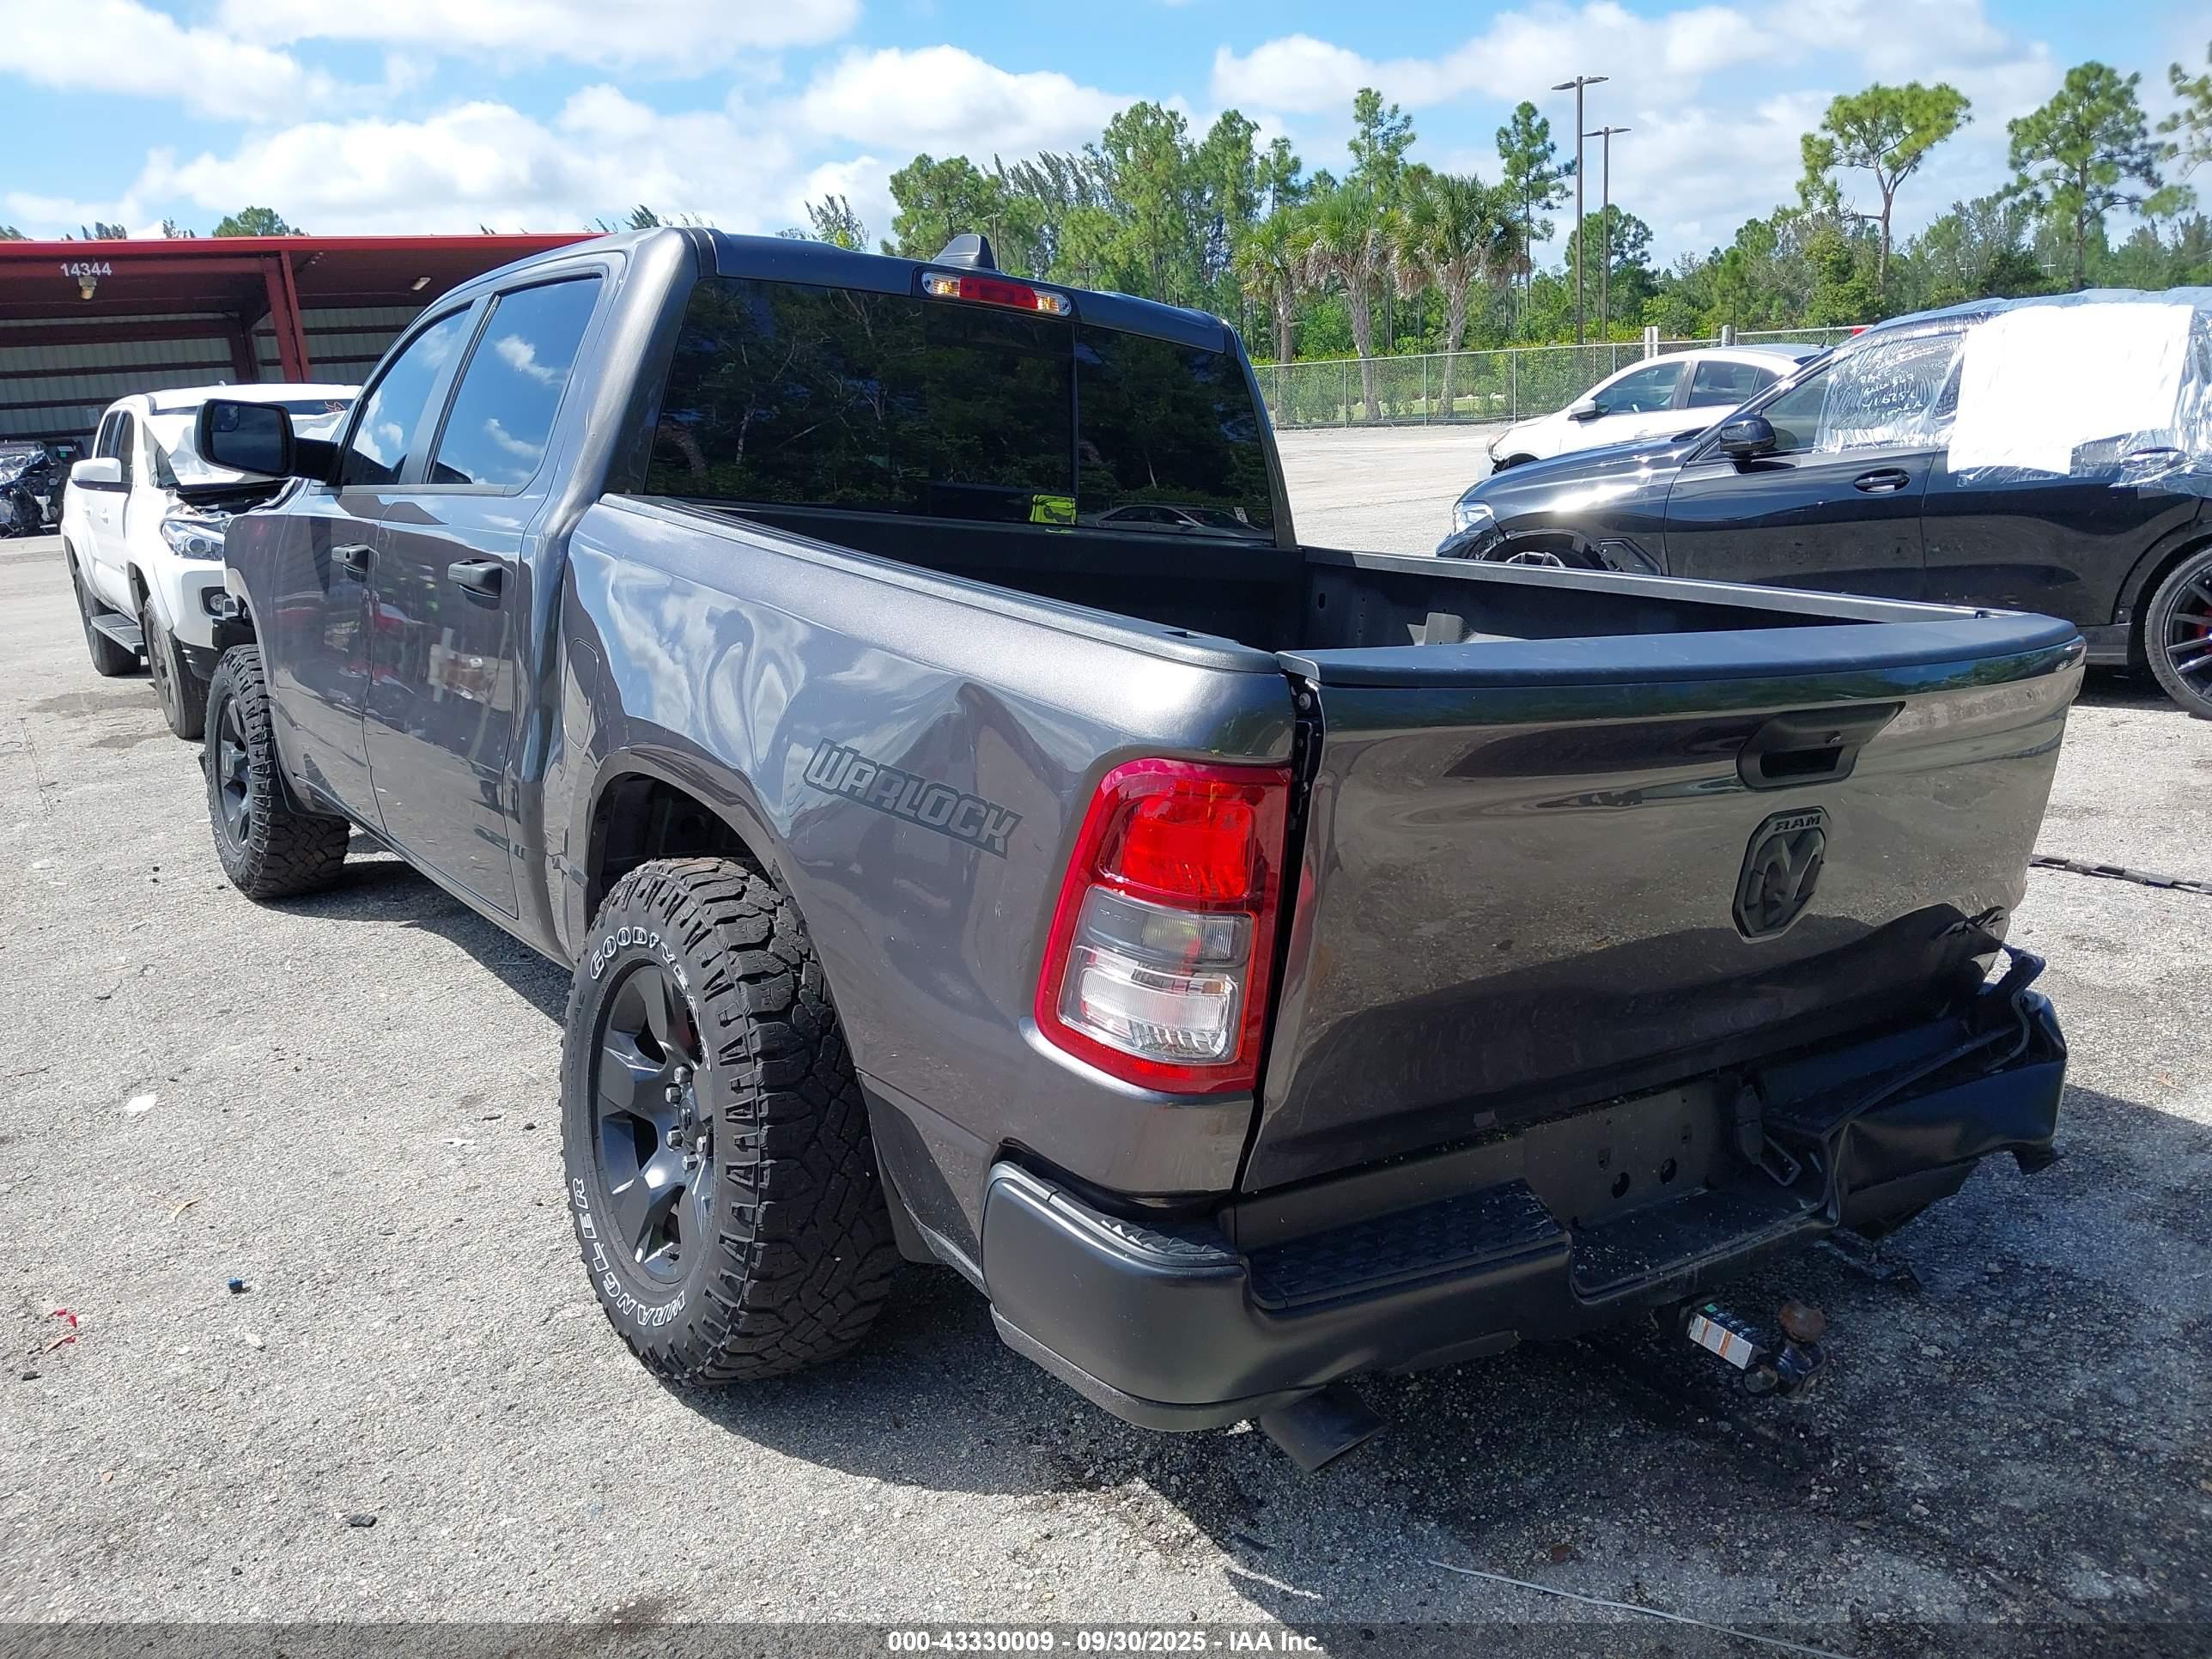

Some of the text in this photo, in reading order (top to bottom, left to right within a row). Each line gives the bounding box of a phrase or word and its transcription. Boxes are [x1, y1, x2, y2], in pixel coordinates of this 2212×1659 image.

[60, 262, 112, 276] 14344
[802, 737, 1024, 860] WARLOCK
[1774, 814, 1821, 831] RAM
[572, 1177, 686, 1327] WRANGLER
